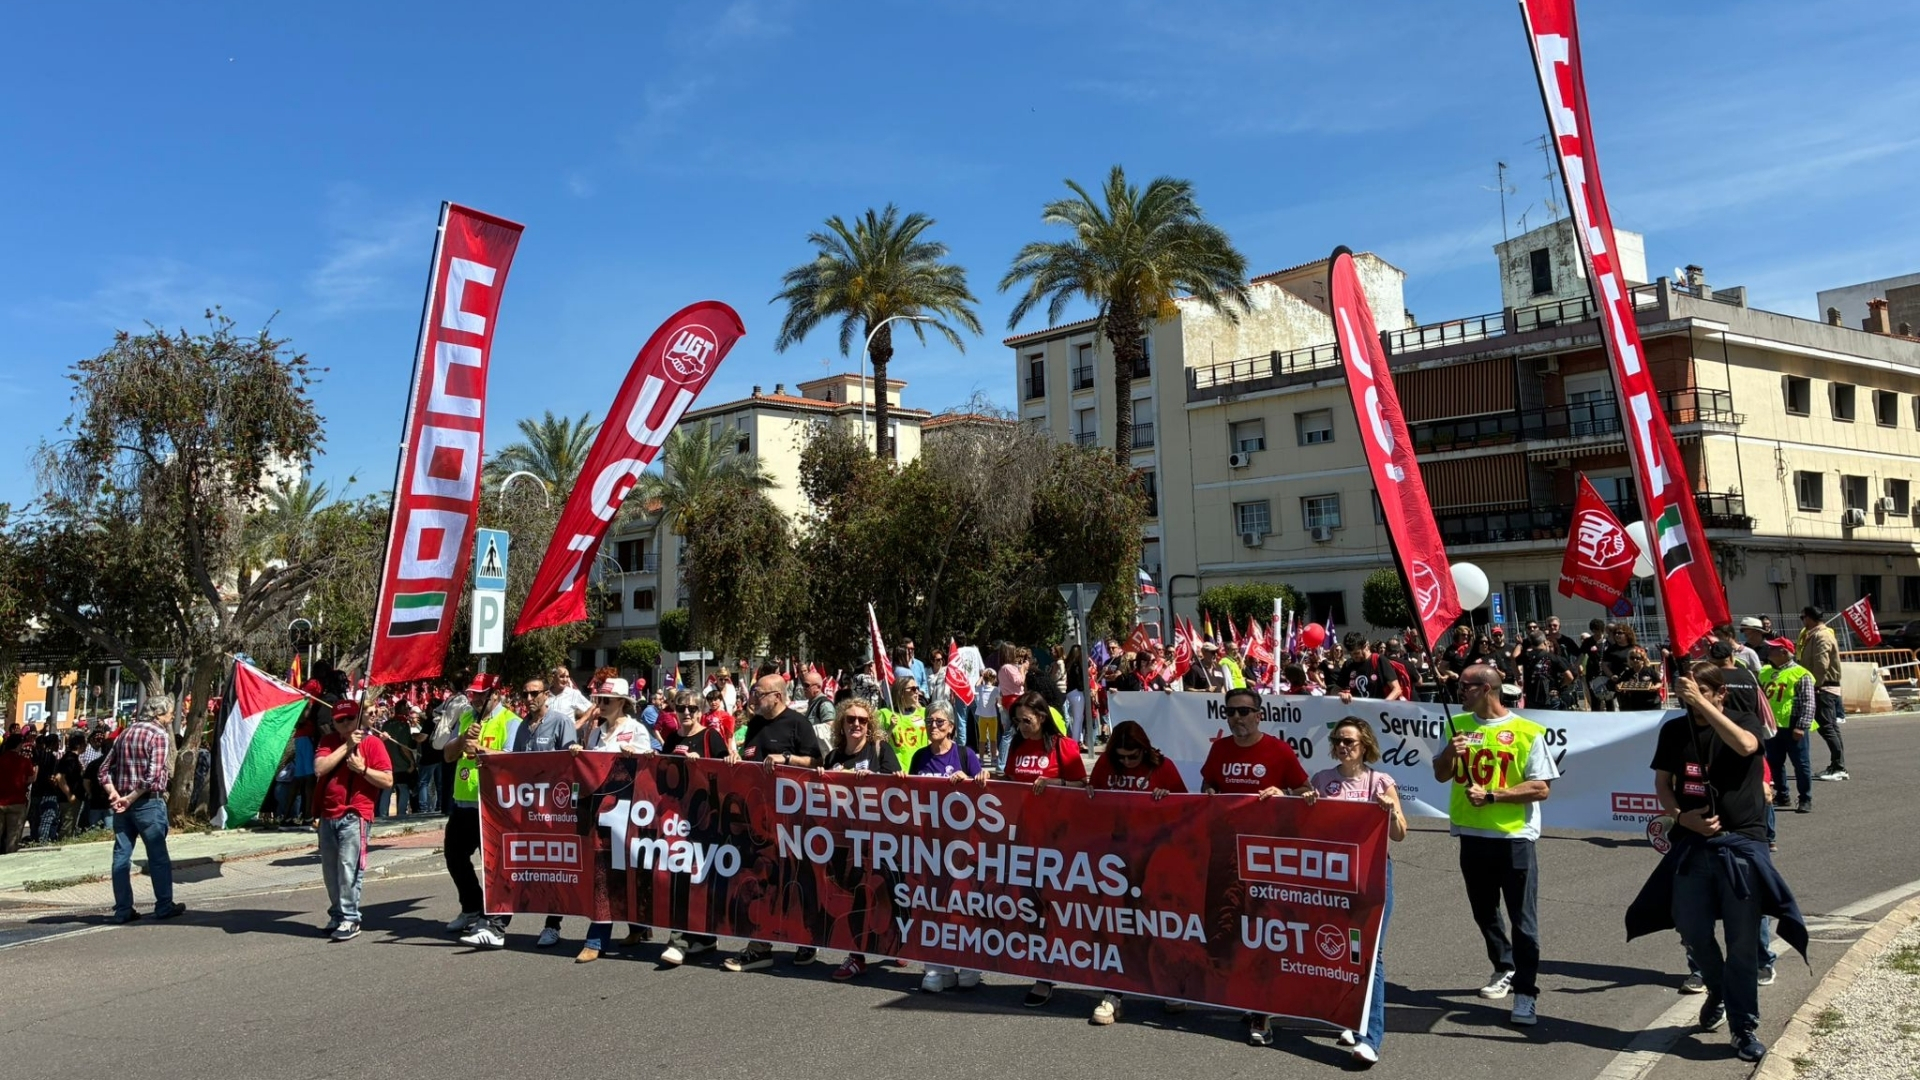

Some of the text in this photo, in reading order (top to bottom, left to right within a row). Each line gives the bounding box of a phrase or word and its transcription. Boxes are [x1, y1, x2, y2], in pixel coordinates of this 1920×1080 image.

[672, 330, 715, 365] UGT
[397, 257, 497, 580] CCOO
[558, 375, 695, 592] UGT
[479, 596, 499, 648] P
[1765, 681, 1788, 703] GT
[27, 705, 39, 719] P
[1260, 702, 1302, 723] alario
[1379, 712, 1567, 746] Servici os
[1015, 755, 1038, 768] UGT
[1382, 739, 1420, 767] de
[1107, 774, 1136, 788] UGT
[1222, 763, 1252, 776] UGT
[496, 782, 549, 809] UGT
[1397, 783, 1419, 792] vicios
[528, 810, 578, 823] Extremadura
[775, 778, 1017, 841] DERECHOS,
[1612, 813, 1635, 822] área
[598, 799, 657, 870] 1º
[663, 813, 691, 838] de
[510, 840, 578, 864] CCOO
[630, 836, 742, 884] mayo
[776, 823, 1142, 898] NO TRINCHERAS.
[1246, 845, 1349, 882] CCOO
[511, 871, 579, 884] extremadura
[1249, 885, 1350, 909] extremadura
[894, 883, 1207, 944] SALARIOS, VIVIENDA
[896, 918, 1124, 974] Y DEMOCRACIA
[1240, 915, 1310, 954] UGT
[1280, 959, 1360, 984] Extremadura
